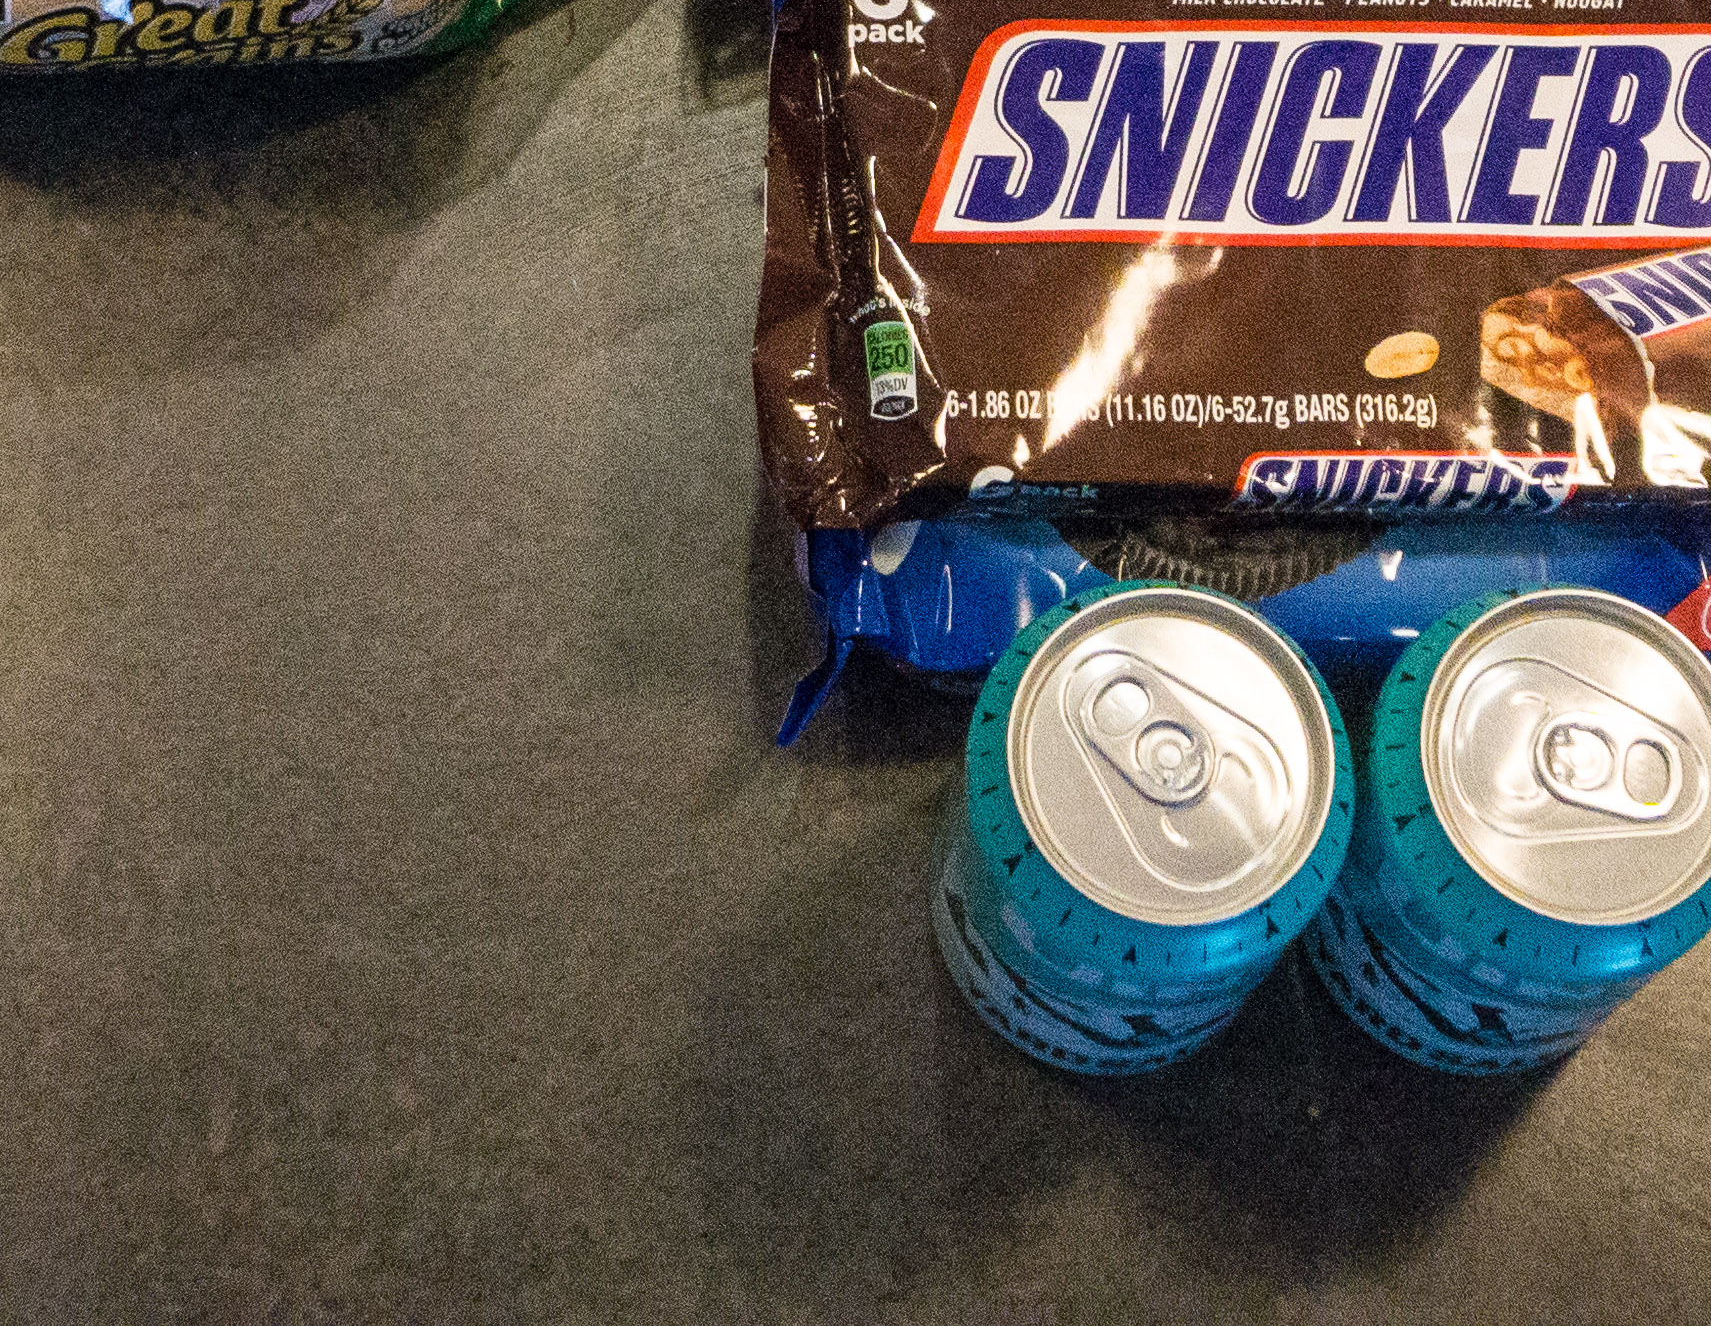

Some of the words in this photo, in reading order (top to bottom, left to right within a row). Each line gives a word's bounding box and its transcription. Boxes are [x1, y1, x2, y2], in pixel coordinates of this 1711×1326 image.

[847, 19, 927, 46] pack
[869, 344, 911, 370] 250
[947, 393, 1012, 422] 6-1.86
[1014, 394, 1043, 421] OZ
[1045, 396, 1101, 421] BS
[1106, 393, 1169, 427] (11.16
[1170, 393, 1291, 429] OZ)/6-52.7g
[1294, 394, 1349, 422] BARS
[1354, 394, 1439, 429] (316.2g)
[1240, 456, 1575, 511] SNICKERS
